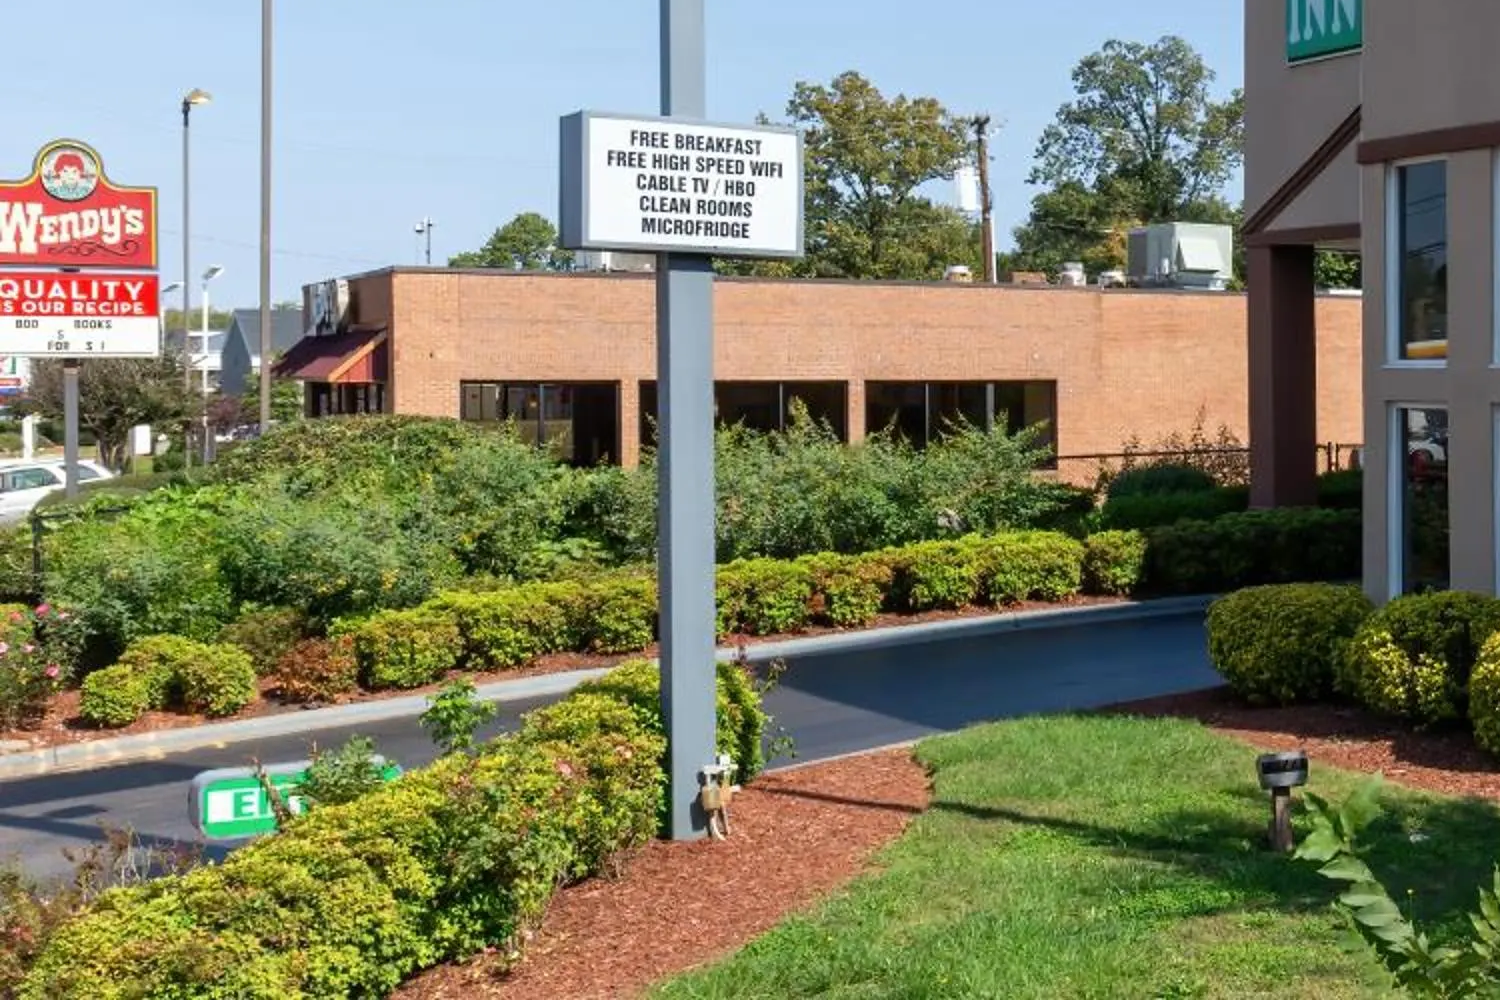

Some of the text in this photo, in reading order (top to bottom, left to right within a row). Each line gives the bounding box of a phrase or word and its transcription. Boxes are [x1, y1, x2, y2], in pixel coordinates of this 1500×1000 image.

[630, 130, 762, 156] FREE BREAKFAST
[607, 150, 783, 178] FREE HIGH SPEED WIFI
[637, 174, 687, 193] CABLE
[692, 178, 708, 194] TV
[724, 180, 756, 197] HBO
[639, 196, 753, 217] CLEAN ROOMS
[641, 218, 750, 239] MICROFRIDGE
[0, 280, 144, 300] QUALITY
[21, 301, 66, 314] OUR
[72, 302, 145, 315] RECIPE
